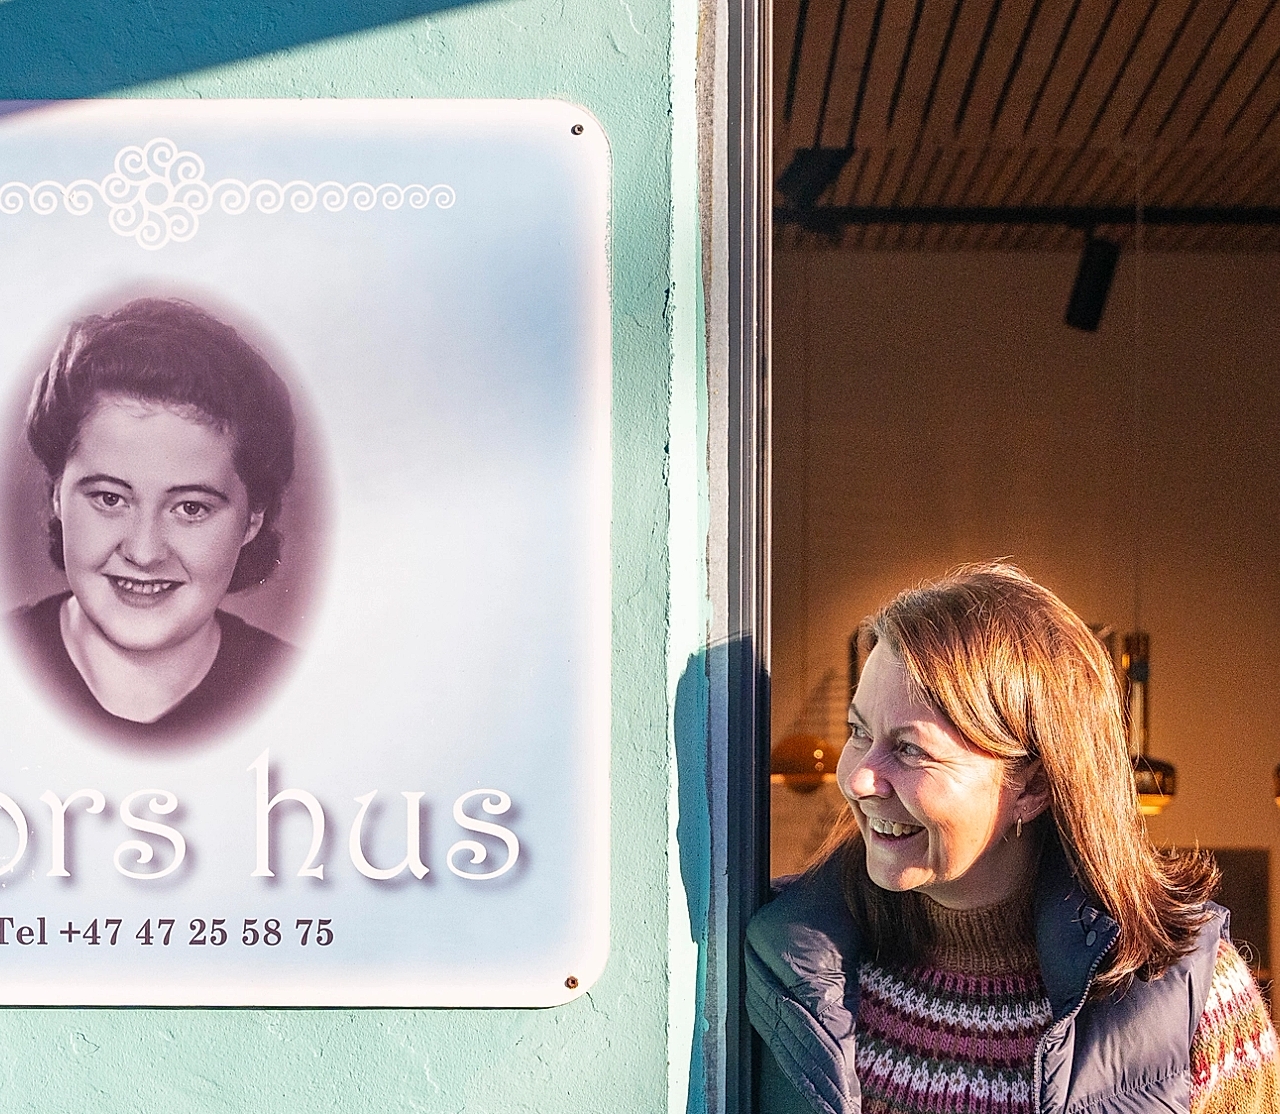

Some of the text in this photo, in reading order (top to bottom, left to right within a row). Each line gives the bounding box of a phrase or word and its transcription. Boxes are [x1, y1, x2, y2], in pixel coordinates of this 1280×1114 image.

[246, 746, 521, 881] hus
[60, 918, 122, 946] +47
[135, 918, 176, 946] 47
[188, 918, 228, 946] 25
[241, 918, 282, 946] 58
[295, 918, 335, 946] 75
